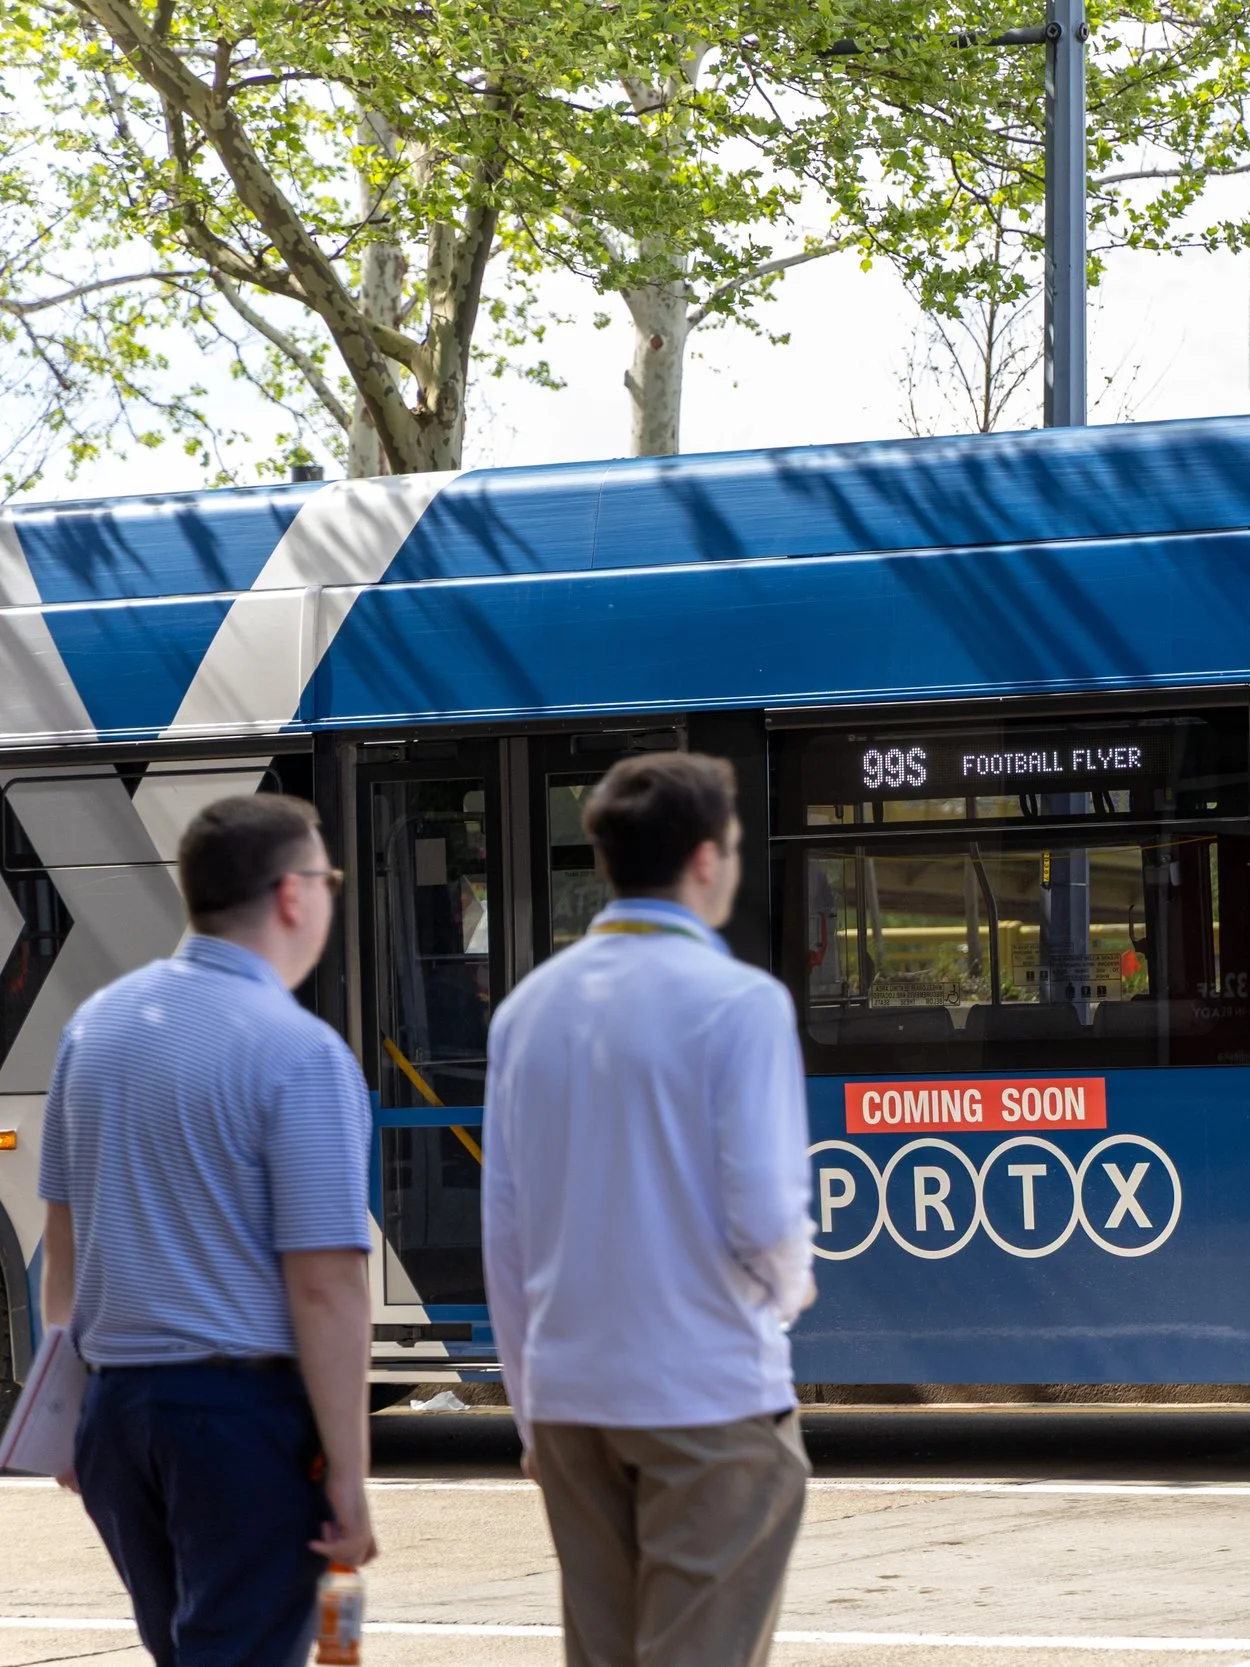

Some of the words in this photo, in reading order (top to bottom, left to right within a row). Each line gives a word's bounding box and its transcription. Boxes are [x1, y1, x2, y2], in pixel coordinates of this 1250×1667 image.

[863, 747, 928, 788] 99S
[963, 750, 1064, 777] FOOTBALL
[1072, 746, 1142, 772] FLYER
[862, 1088, 983, 1126] COMING
[1001, 1086, 1086, 1123] SOON
[818, 1162, 1153, 1233] PRTX
